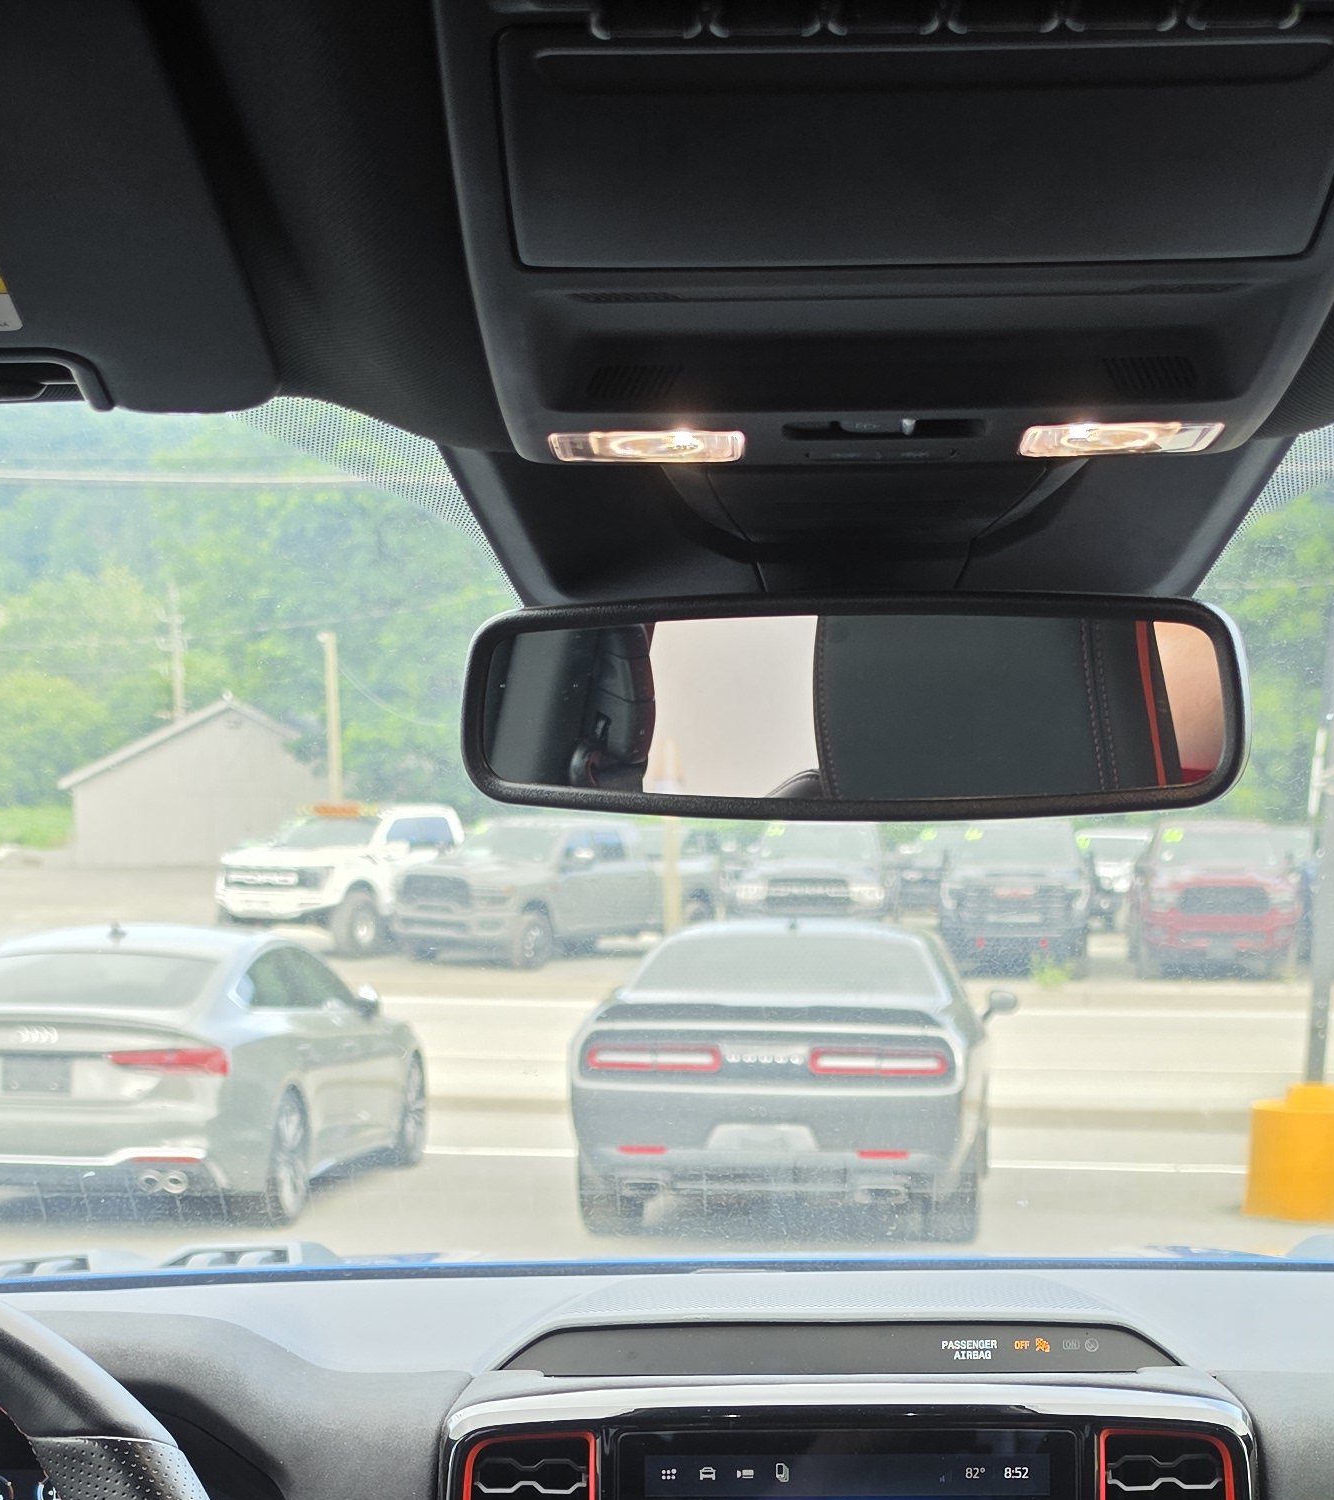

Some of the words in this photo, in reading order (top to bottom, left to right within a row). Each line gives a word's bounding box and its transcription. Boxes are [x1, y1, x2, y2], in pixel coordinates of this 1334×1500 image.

[940, 1338, 998, 1350] PASSENGER
[1013, 1340, 1030, 1350] OFF
[953, 1350, 992, 1361] AIRBAG
[1003, 1465, 1030, 1481] 8:52
